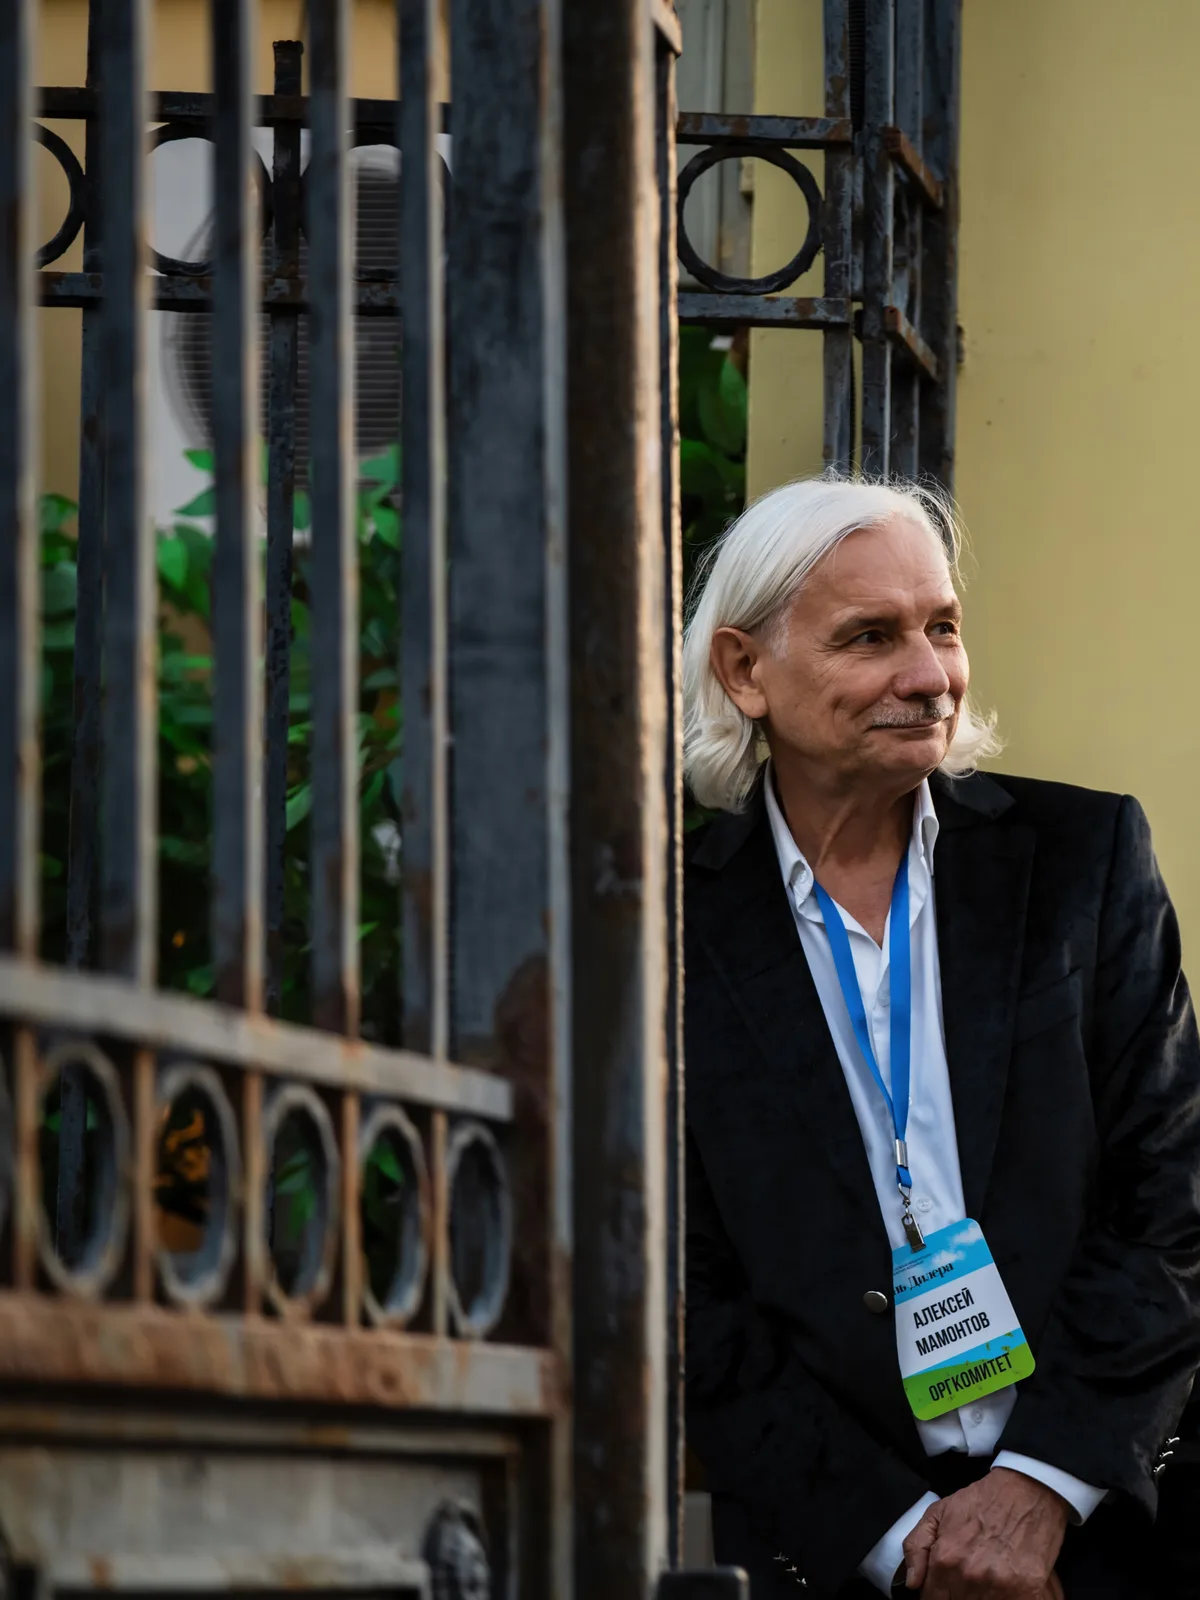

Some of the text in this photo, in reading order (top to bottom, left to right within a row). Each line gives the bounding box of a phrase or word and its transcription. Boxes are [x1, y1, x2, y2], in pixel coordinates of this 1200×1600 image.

[908, 1262, 954, 1290] Дилера
[913, 1287, 975, 1329] АЛЕКСЕЙ
[915, 1311, 990, 1356] МАМОНТОВ
[928, 1353, 1013, 1402] ОРГКОМИТЕТ
